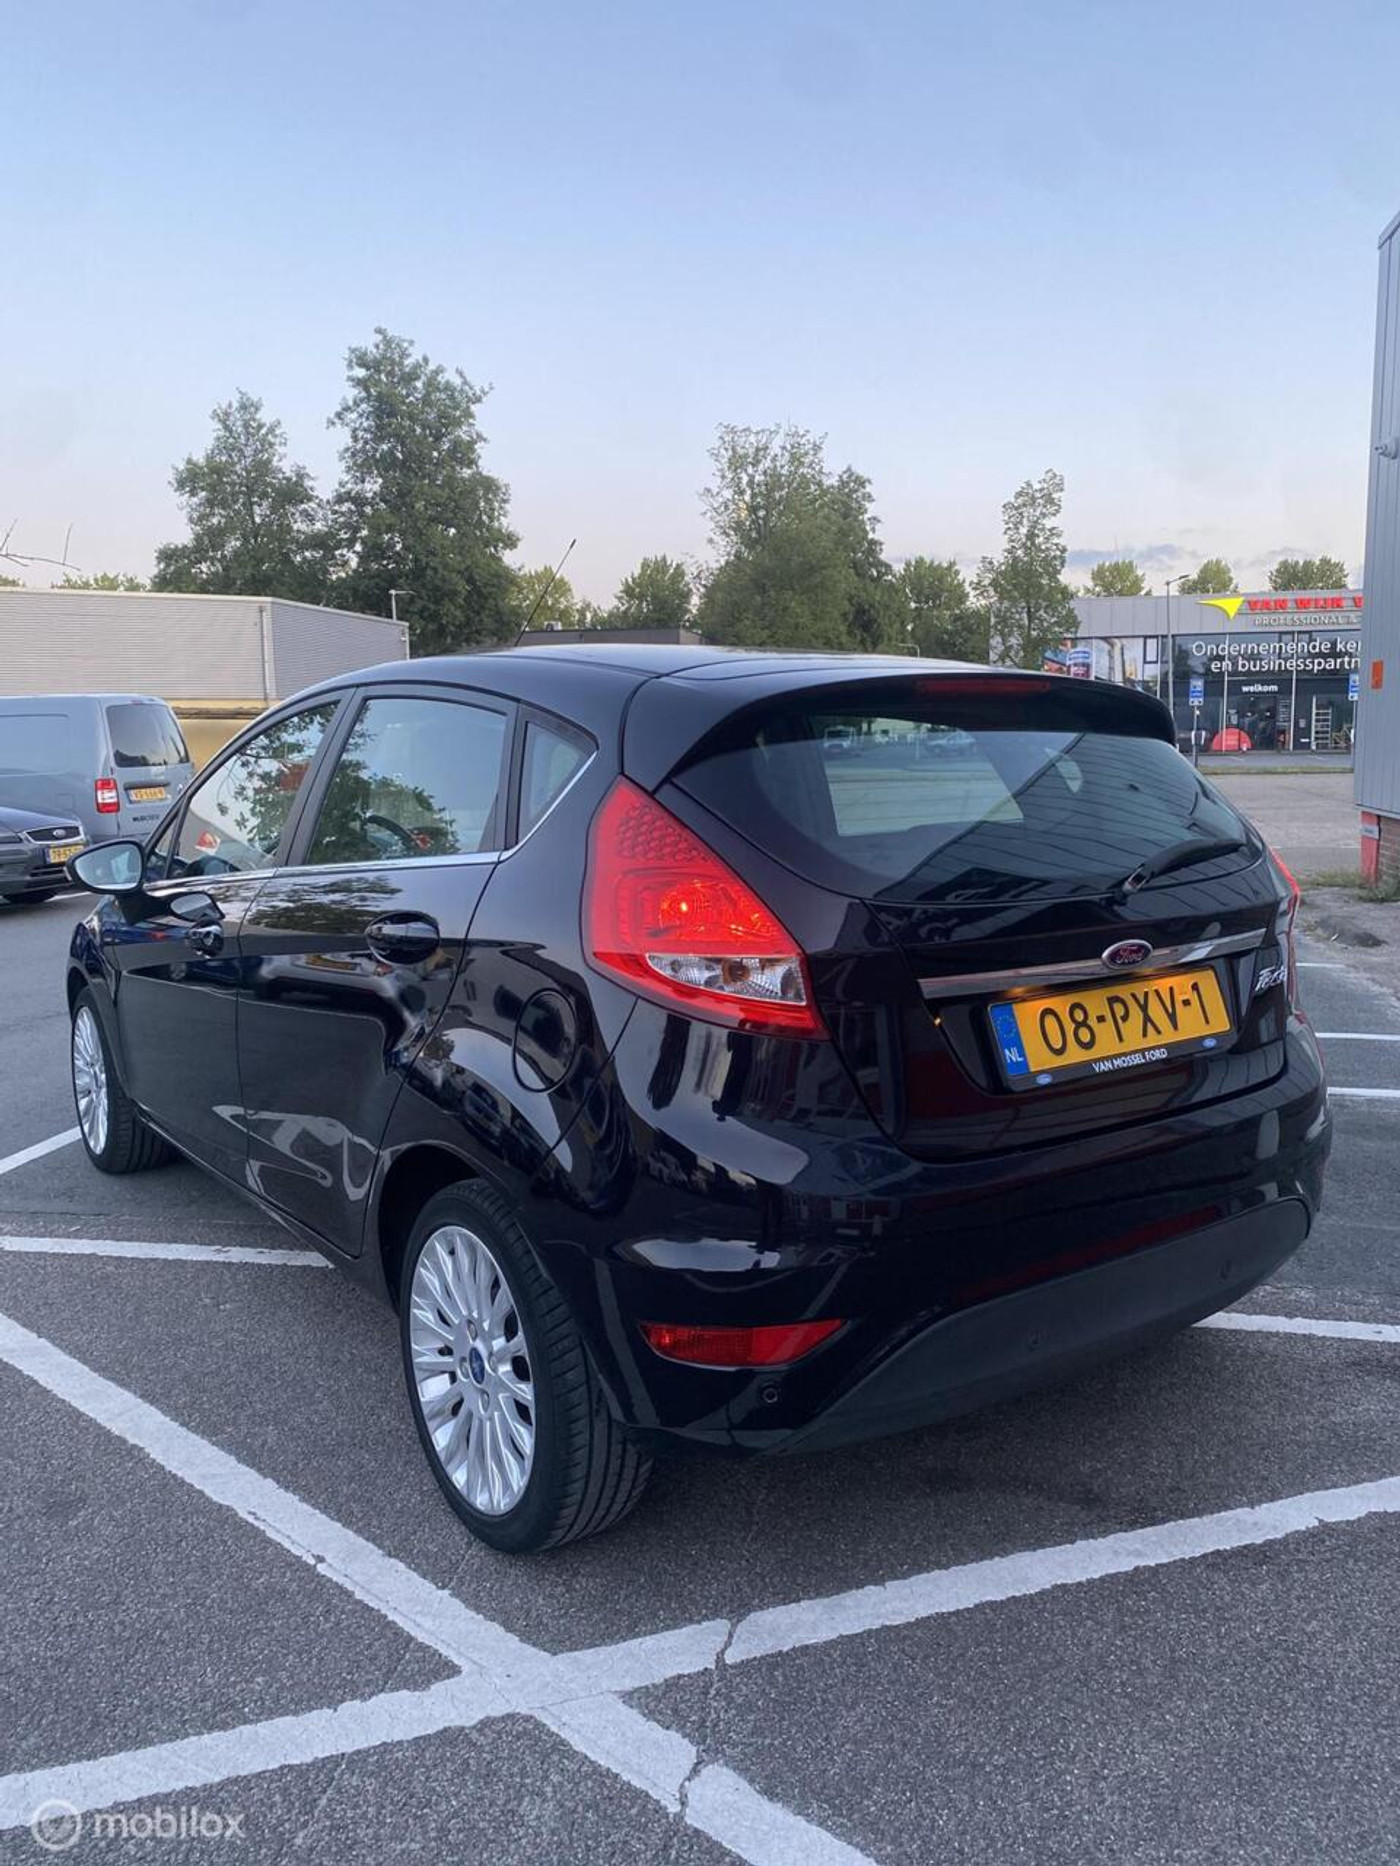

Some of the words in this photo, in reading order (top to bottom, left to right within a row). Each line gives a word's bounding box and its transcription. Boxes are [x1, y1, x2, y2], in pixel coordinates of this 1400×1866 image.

[1247, 597, 1289, 611] VAN
[1295, 595, 1345, 609] WIJK
[1255, 614, 1344, 627] PROFESSIONAL
[1192, 638, 1331, 656] Ondernemende
[1211, 659, 1232, 672] en
[1241, 683, 1278, 693] welkom
[1114, 945, 1145, 964] Ford
[1038, 981, 1210, 1056] 08-PXV-1
[1004, 1046, 1024, 1064] NL
[1092, 1060, 1114, 1073] VAN
[1113, 1052, 1145, 1069] MOSSEL
[1145, 1048, 1168, 1061] FORD
